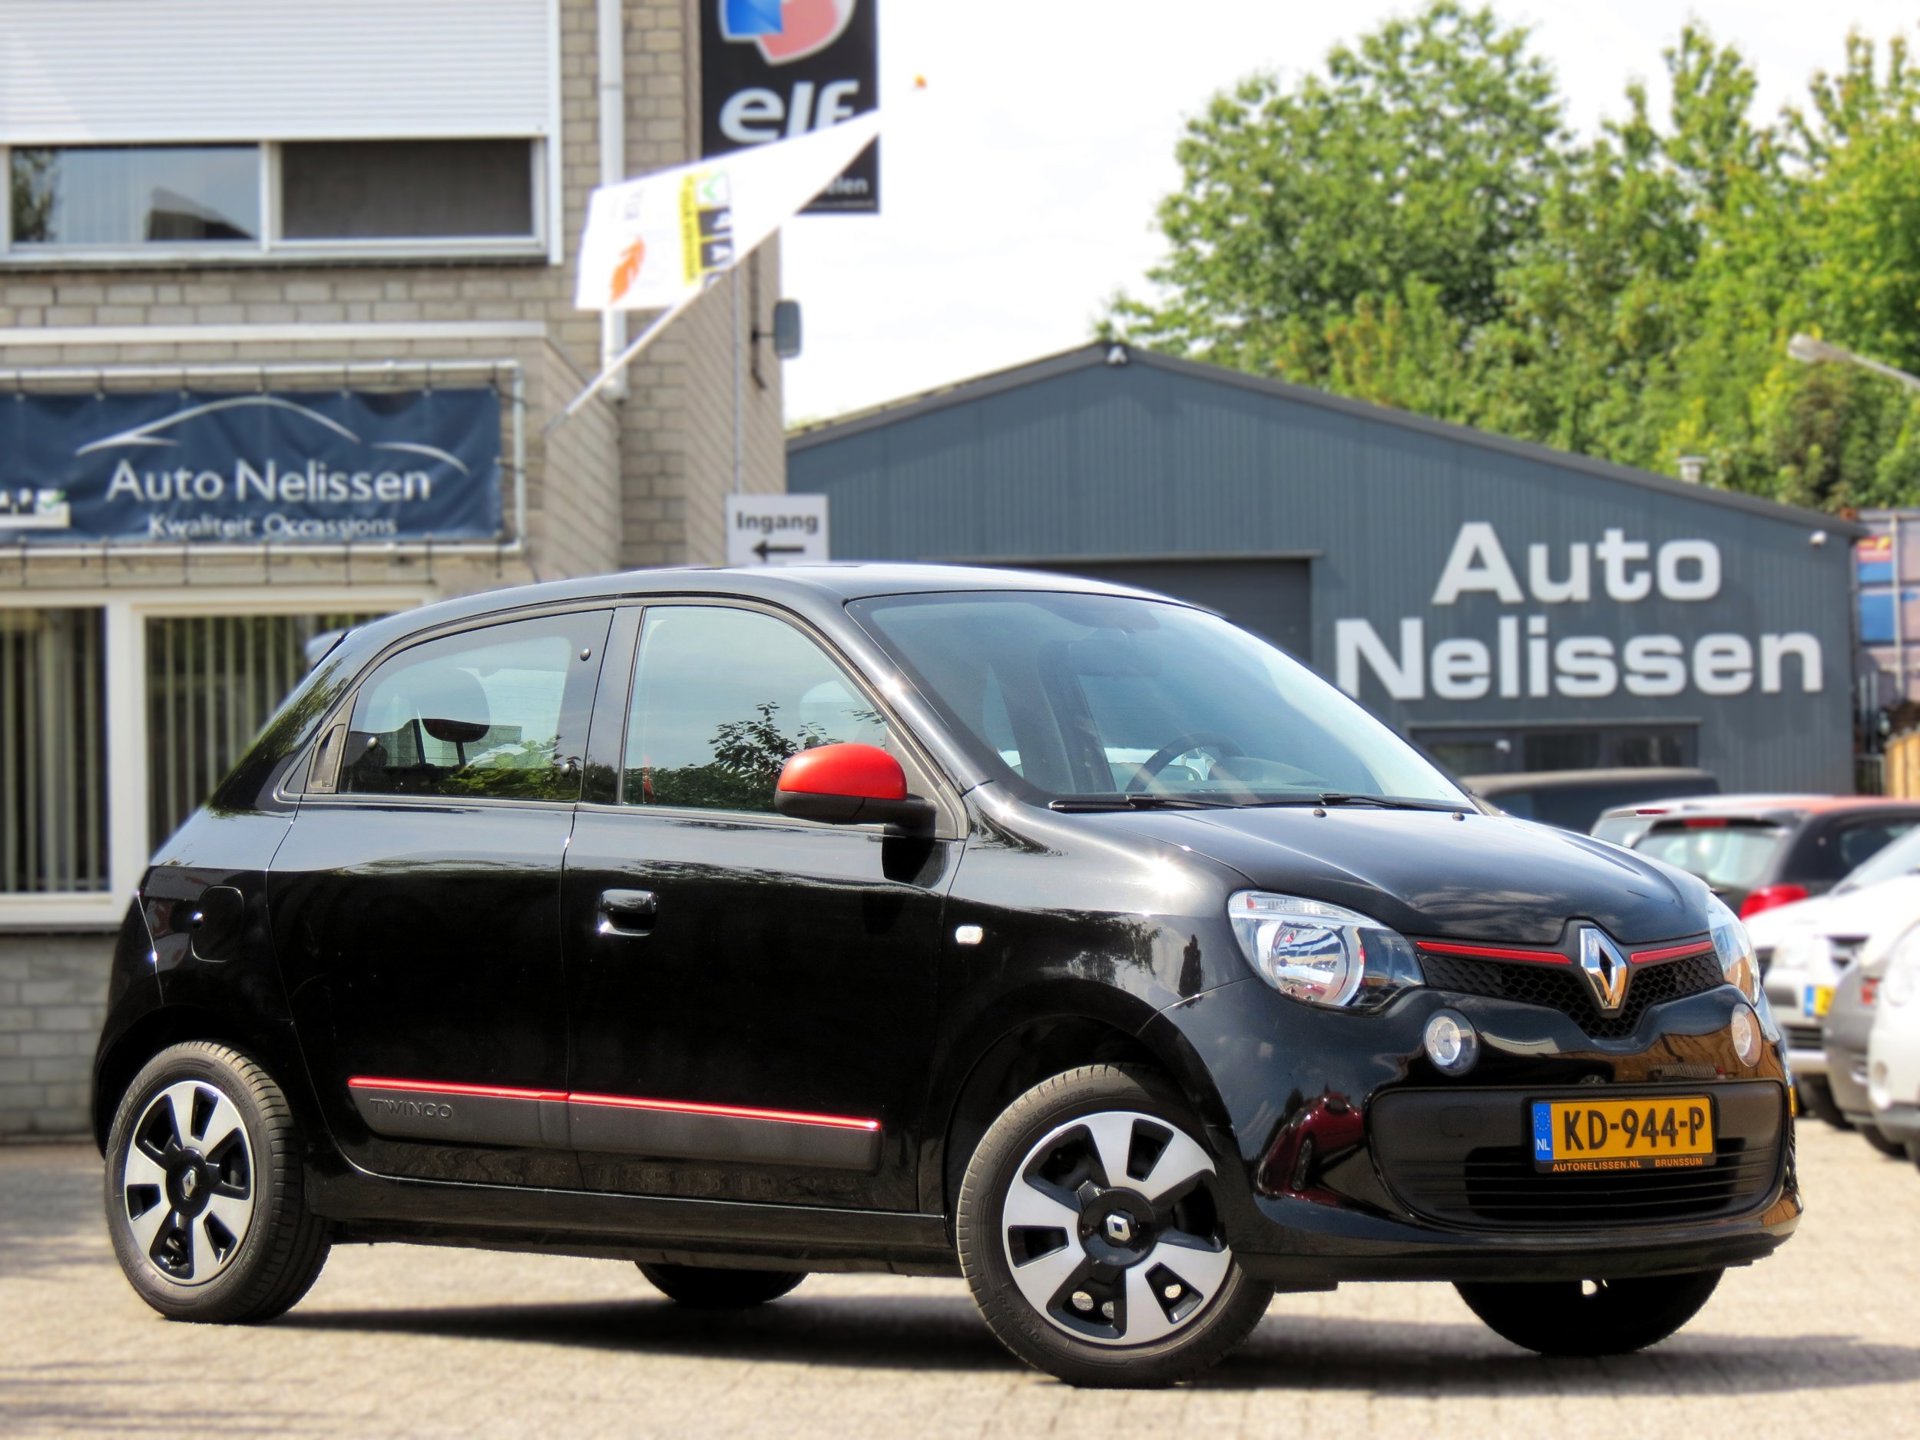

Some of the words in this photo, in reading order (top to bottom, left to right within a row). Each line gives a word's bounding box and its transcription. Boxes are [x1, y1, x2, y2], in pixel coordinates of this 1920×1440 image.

[719, 80, 859, 143] elf
[106, 458, 222, 501] Auto
[236, 458, 431, 501] Nelissen
[149, 512, 255, 537] Kwaliteit
[263, 512, 398, 537] Occassions
[736, 510, 818, 535] Ingang
[1431, 521, 1721, 604] Auto
[1335, 615, 1823, 699] Nelissen
[369, 1098, 453, 1120] TWINGO
[1536, 1137, 1551, 1151] NL
[1563, 1106, 1705, 1152] KD-944-P
[1552, 1159, 1642, 1173] AUTONELISSEN.NL
[1654, 1157, 1704, 1168] BRUNSSUM
